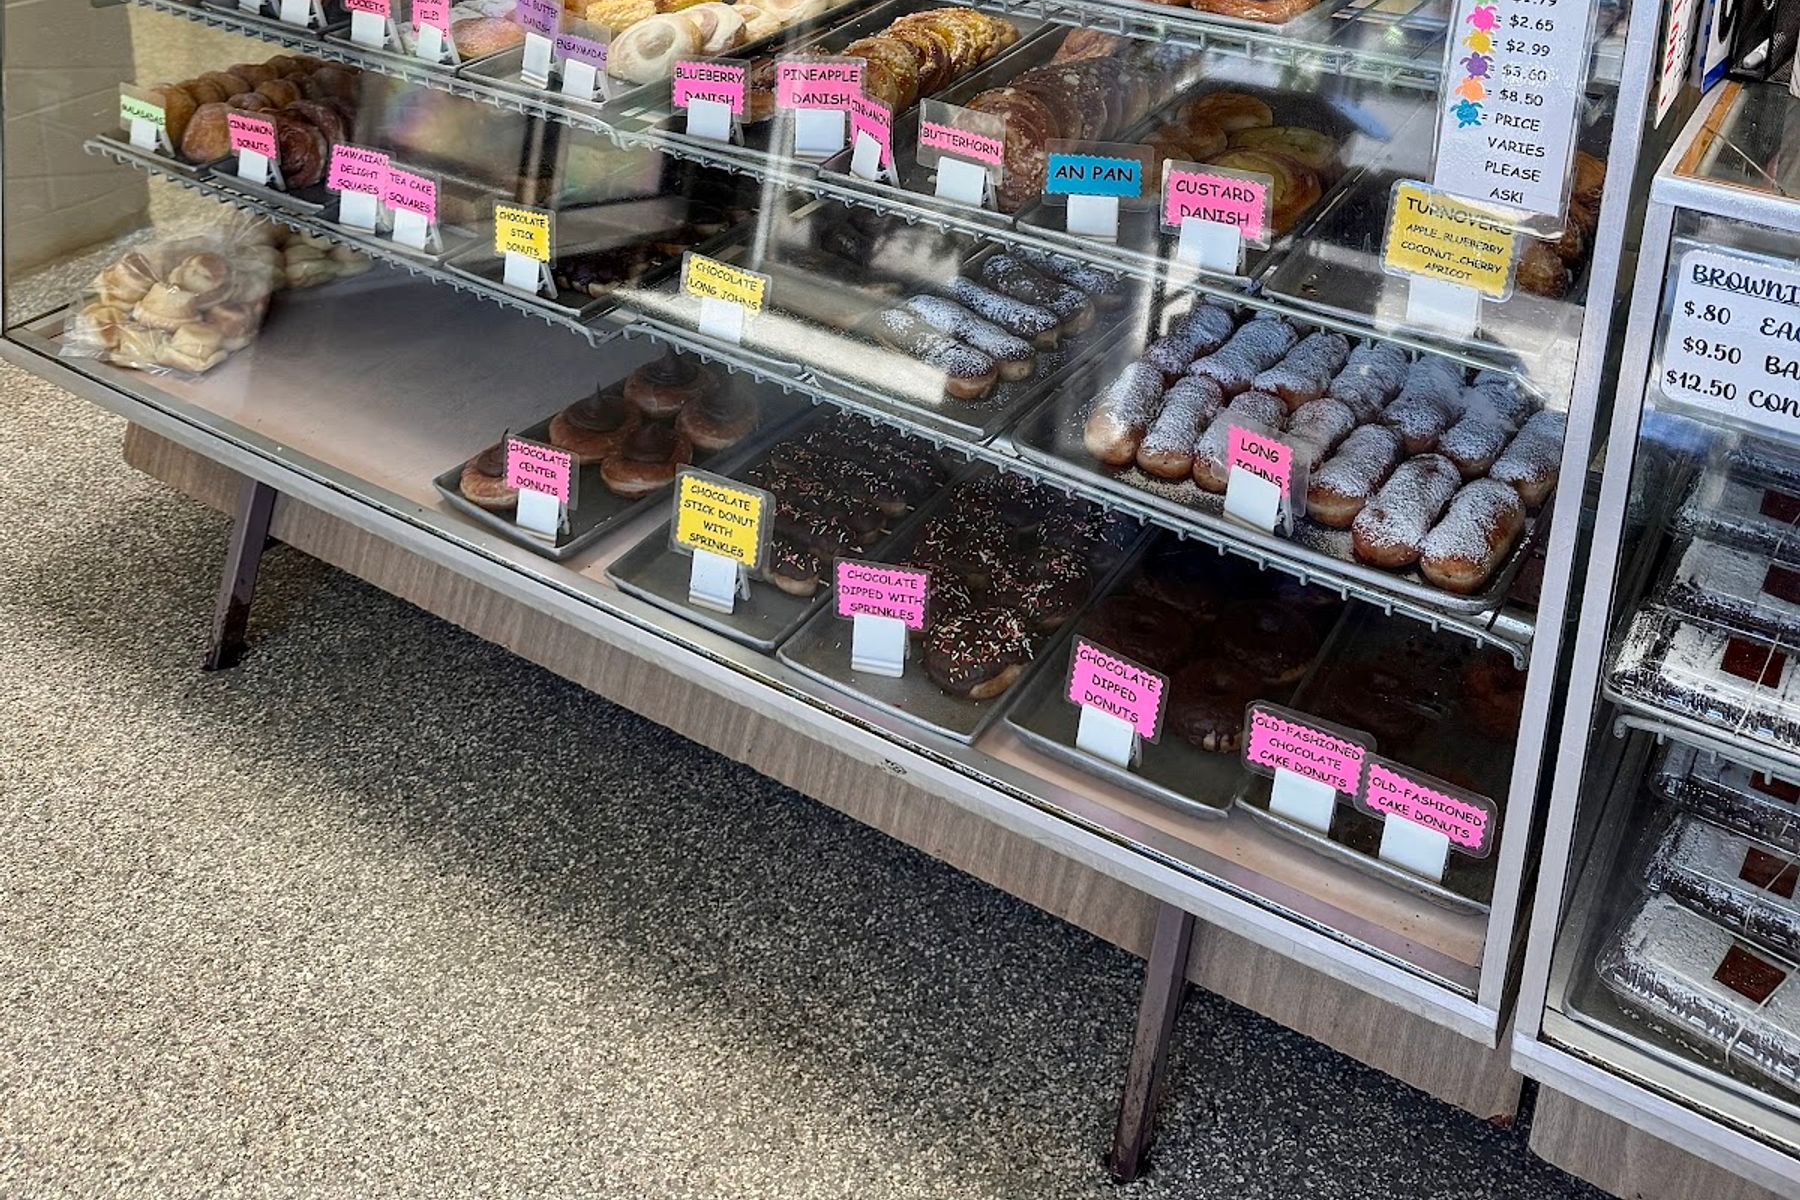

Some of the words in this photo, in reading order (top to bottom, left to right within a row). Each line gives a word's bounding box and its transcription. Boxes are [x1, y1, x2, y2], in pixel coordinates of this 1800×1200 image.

[1509, 14, 1554, 32] $2.65
[1505, 39, 1551, 57] $2.99
[676, 67, 743, 84] BLUEBERRY
[782, 68, 859, 83] PINEAPPLE
[684, 90, 735, 106] DANISH
[792, 92, 850, 106] DANISH
[1499, 89, 1544, 107] $8.50
[230, 119, 274, 137] CINNAMON
[1495, 113, 1541, 132] PRICE
[236, 137, 270, 153] DONUTS
[922, 125, 999, 156] BUTTERHORN
[1487, 135, 1545, 158] VARIES
[336, 147, 388, 167] HAWAIIAN
[340, 163, 379, 180] DELIGHT
[1055, 165, 1085, 180] AN
[1092, 166, 1133, 182] PAN
[1484, 161, 1542, 183] PLEASE
[337, 179, 380, 196] SQUARES
[389, 172, 407, 187] TEA
[409, 177, 433, 196] CAKE
[1175, 179, 1256, 203] CUSTARD
[387, 190, 431, 213] SQUARES
[1489, 187, 1523, 204] ASK!
[499, 210, 546, 228] CHOCOLATE
[1180, 204, 1250, 226] DANISH
[510, 227, 535, 241] STICK
[505, 241, 540, 257] DONUTS
[695, 261, 759, 292] CHOCOLATE
[1425, 262, 1472, 280] APRICOT
[689, 277, 717, 295] LONG
[720, 289, 758, 311] JOHNS
[1684, 300, 1731, 325] $.80
[1682, 336, 1742, 365] $9.50
[1666, 368, 1738, 400] $12.50
[510, 441, 570, 469] CHOCOLATE
[1240, 437, 1280, 464] LONG
[518, 461, 558, 480] CENTER
[1235, 458, 1283, 488] JOHNS
[516, 475, 559, 497] DONUTS
[690, 484, 751, 512] CHOCOLATE
[683, 499, 716, 516] STICK
[718, 508, 756, 528] DONUT
[703, 519, 734, 538] WITH
[688, 532, 745, 558] SPRINKLES
[846, 569, 918, 590] CHOCOLATE
[841, 584, 884, 600] DIPPED
[888, 590, 923, 606] WITH
[849, 601, 916, 621] SPRINKLES
[1079, 649, 1157, 693] CHOCOLATE
[1091, 674, 1137, 704] DIPPED
[1083, 690, 1139, 724] DONUTS
[1255, 714, 1361, 762] OLD-FASHIONED
[1268, 735, 1342, 771] CHOCOLATE
[1259, 749, 1291, 770] CAKE
[1293, 760, 1347, 788] DONUTS
[1371, 774, 1483, 828] OLD-FASHIONED
[1378, 795, 1410, 815] CAKE
[1414, 809, 1471, 840] DONUTS
